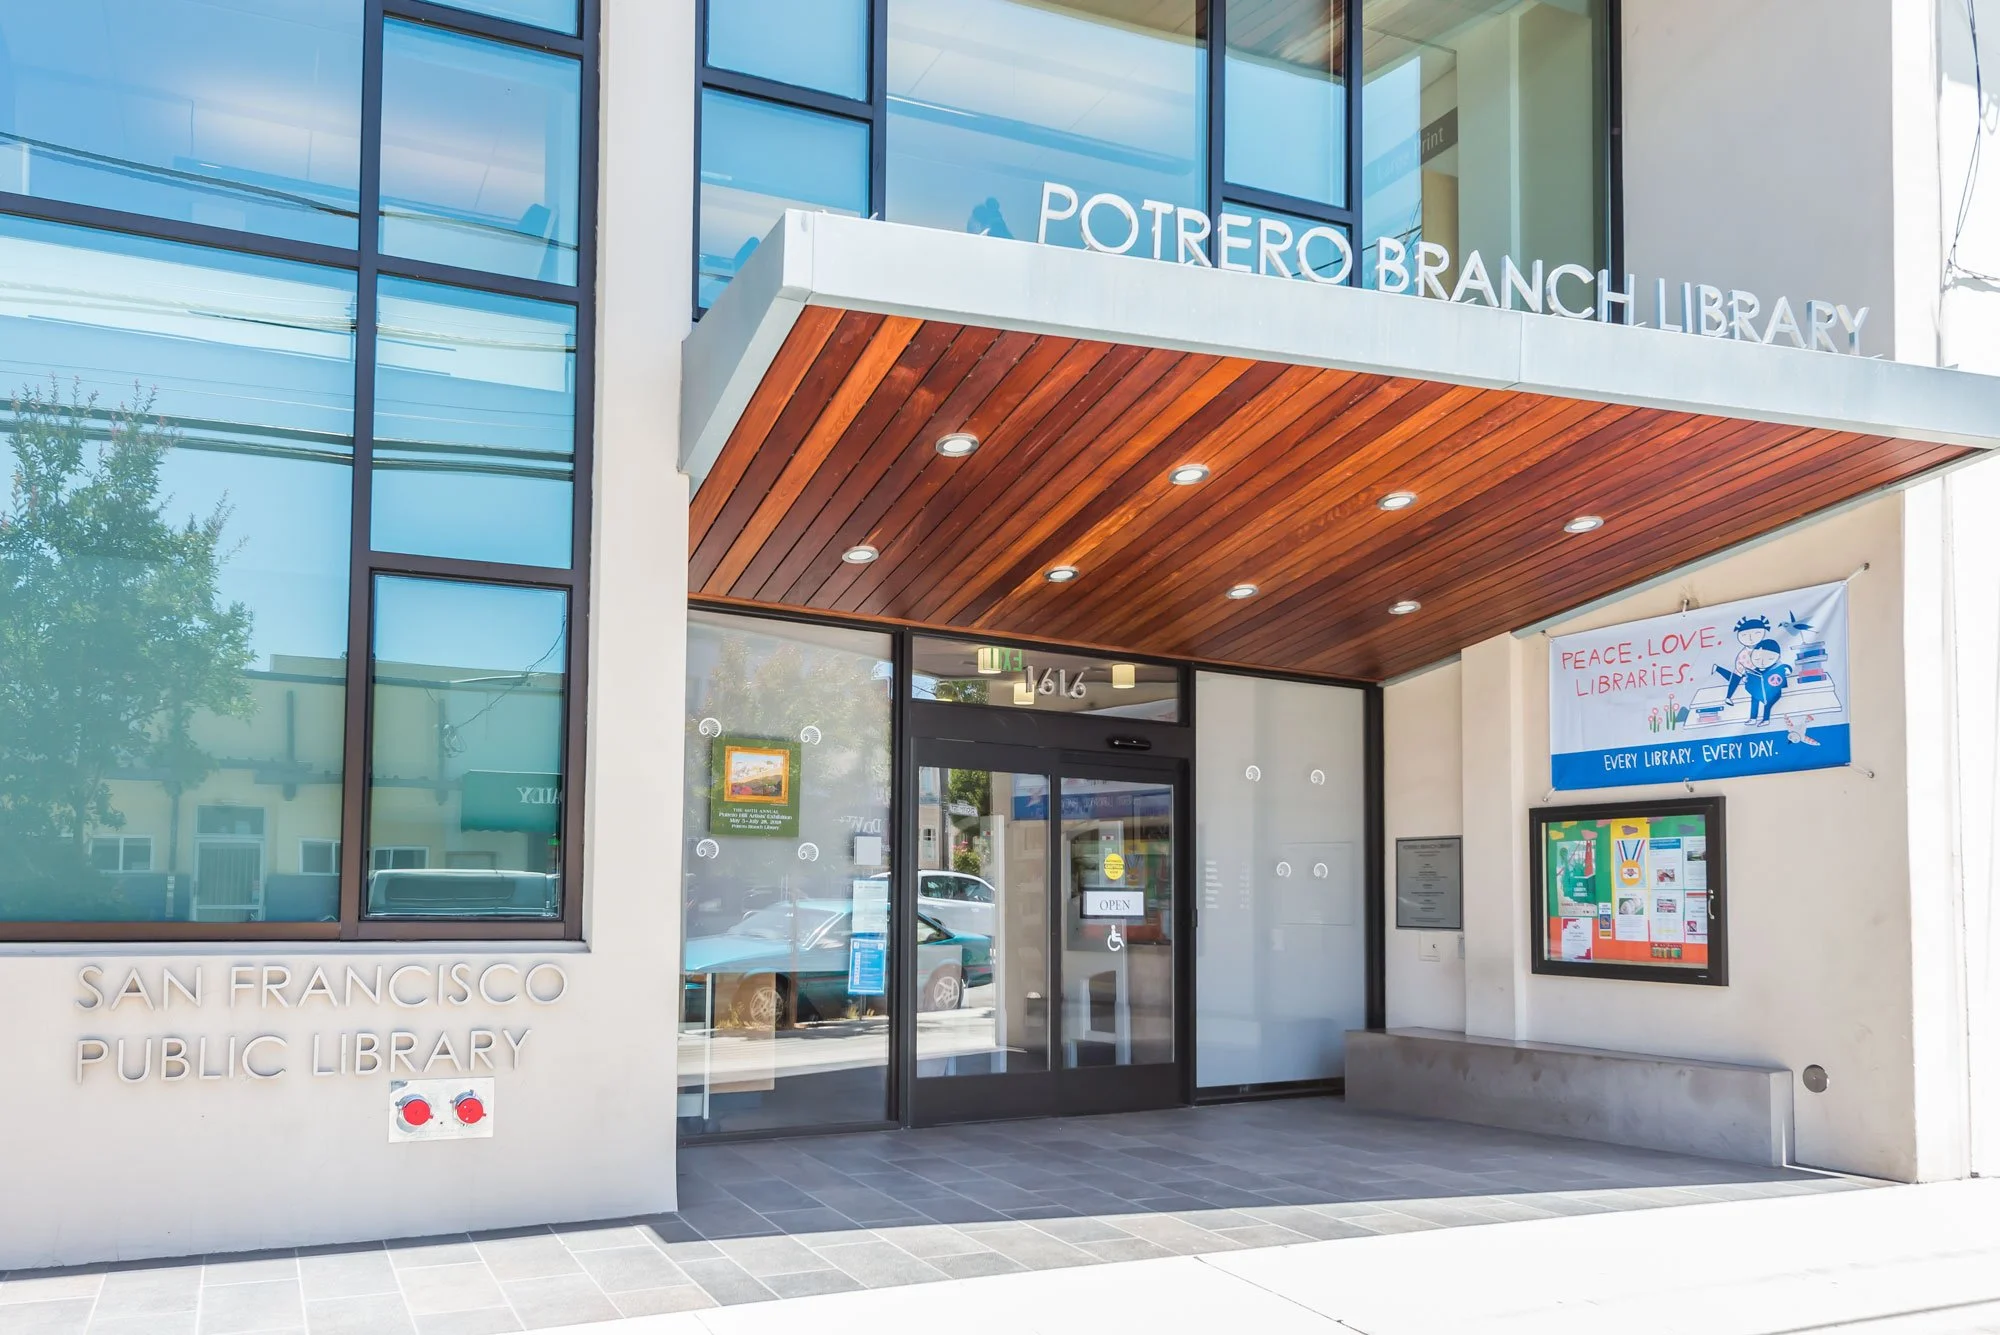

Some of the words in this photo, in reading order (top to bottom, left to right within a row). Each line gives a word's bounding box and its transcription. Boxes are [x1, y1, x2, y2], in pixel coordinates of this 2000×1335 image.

[1037, 181, 1352, 286] POTRERO
[1378, 236, 1635, 325] BRANCH
[1657, 277, 1870, 357] LIBRARY
[1561, 642, 1643, 670] PEACE.
[1648, 626, 1723, 657] LOVE.
[1025, 665, 1087, 698] 1616
[1604, 752, 1637, 771] EVERY
[1644, 748, 1695, 768] LIBRARY.
[1702, 743, 1743, 763] EVERY
[1749, 739, 1778, 758] DAY.
[1100, 899, 1131, 911] OPEN
[75, 964, 203, 1011] SAN
[230, 962, 569, 1008] FRANCISCO
[76, 1035, 288, 1084] PUBLIC
[313, 1028, 533, 1077] LIBRARY
